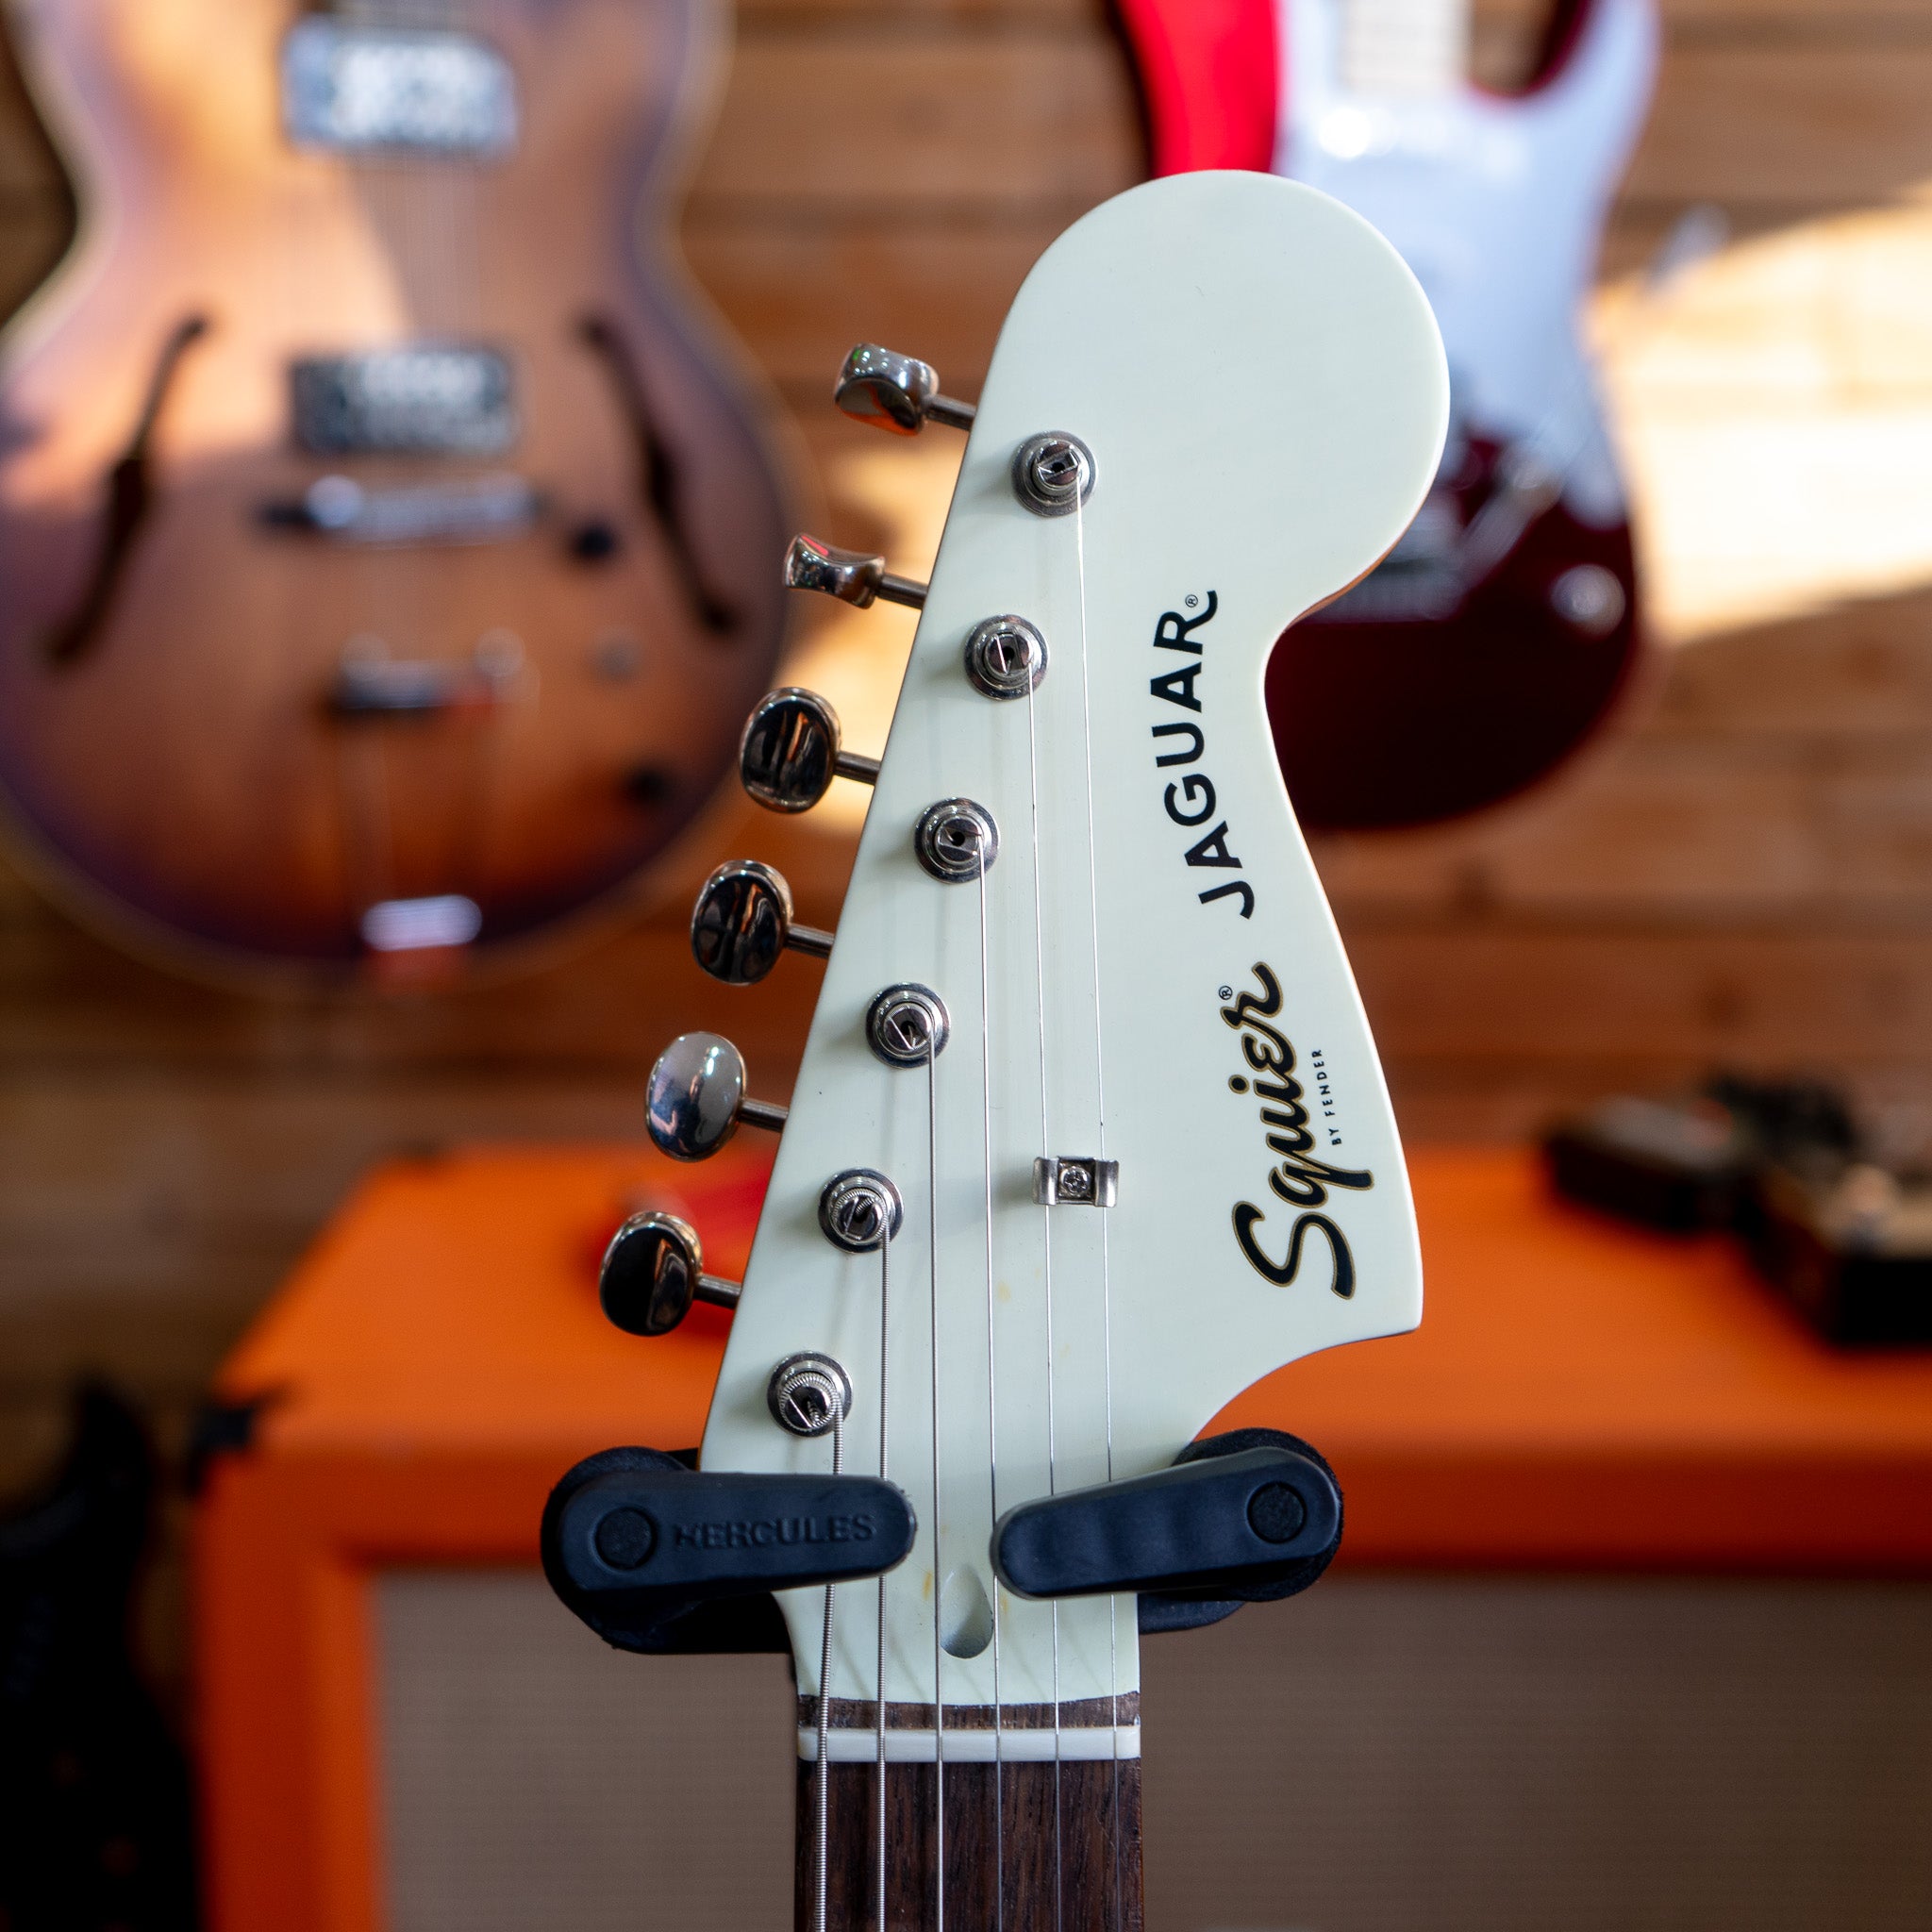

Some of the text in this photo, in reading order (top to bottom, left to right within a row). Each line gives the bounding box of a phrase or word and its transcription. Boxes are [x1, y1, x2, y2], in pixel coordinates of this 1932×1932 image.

[1311, 1049, 1342, 1145] BY FENDER
[675, 1513, 877, 1550] HERCULES
